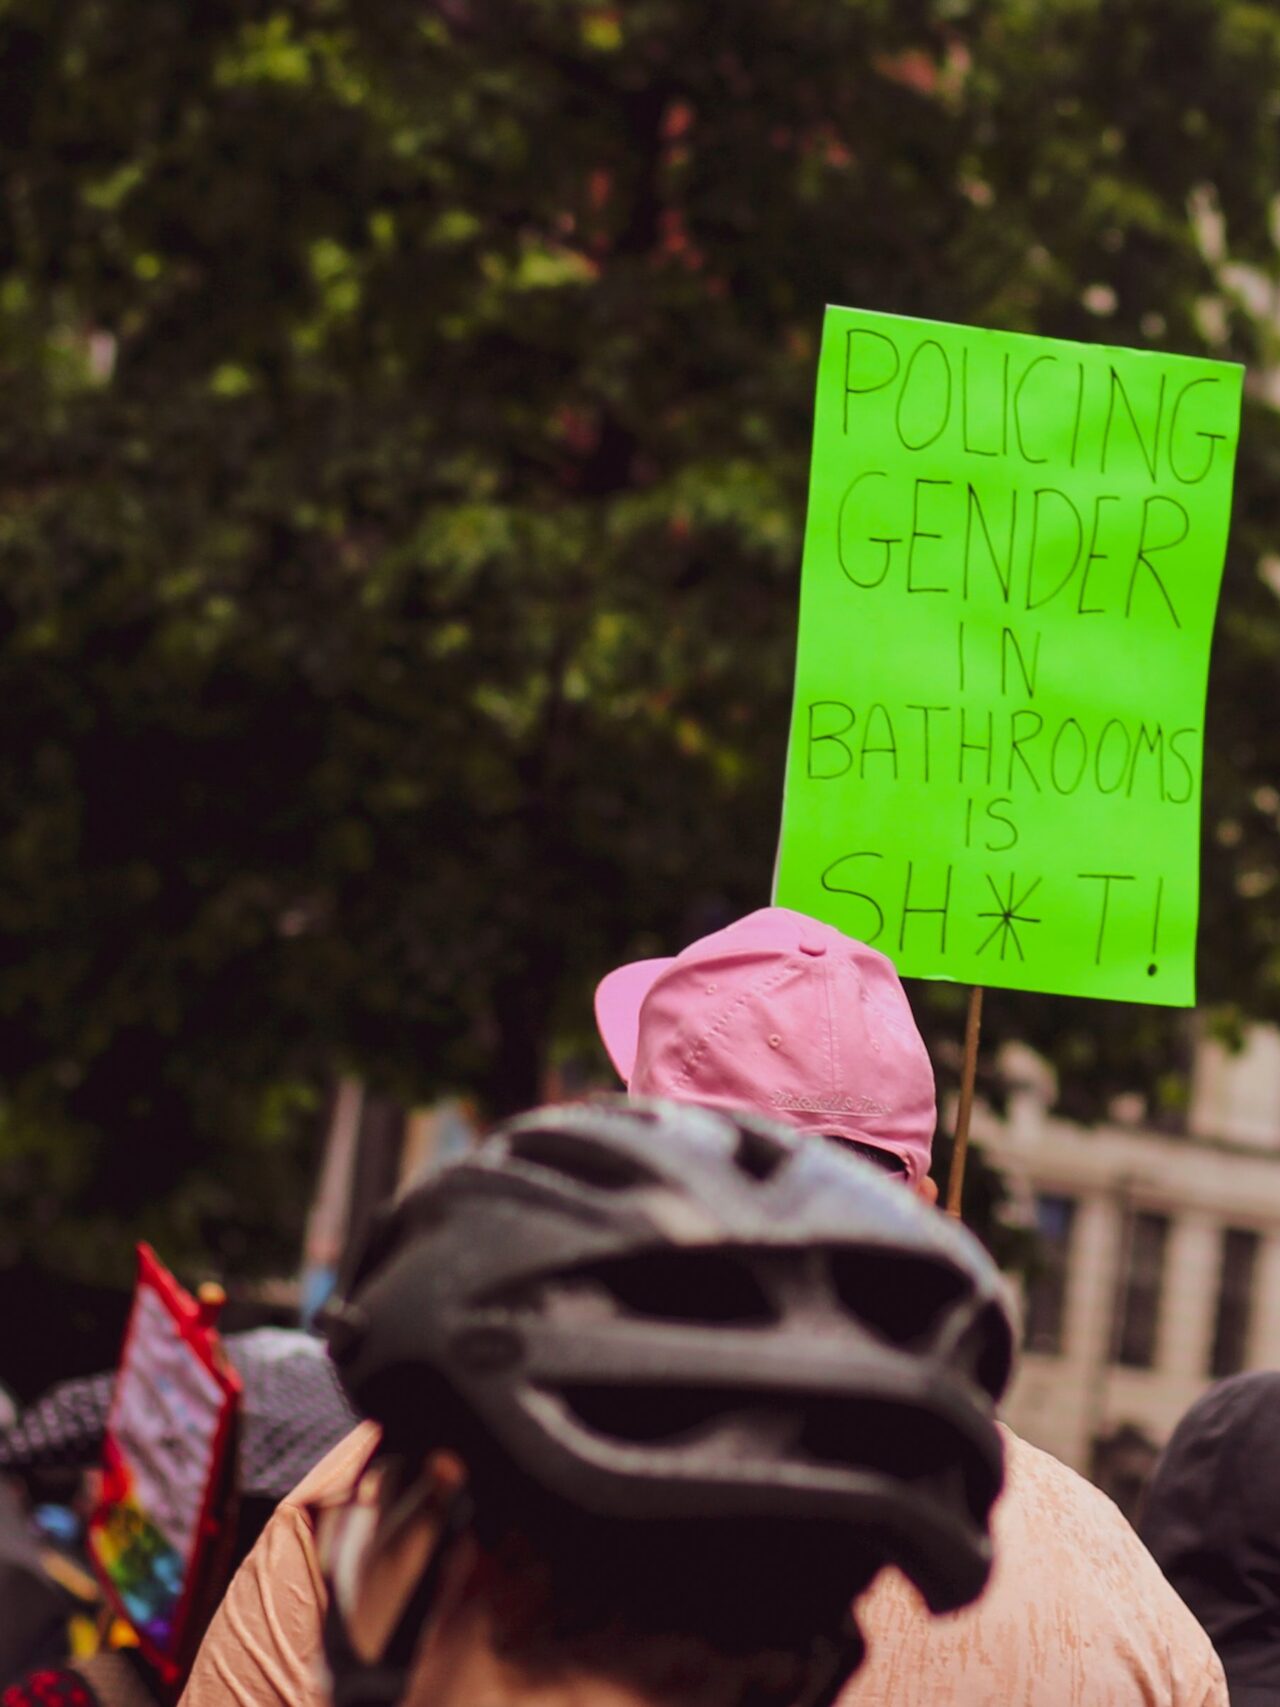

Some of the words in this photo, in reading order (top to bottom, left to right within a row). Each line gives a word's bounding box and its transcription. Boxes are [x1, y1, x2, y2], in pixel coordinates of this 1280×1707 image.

[842, 328, 1227, 484] POLICING
[837, 471, 1190, 628] GENDER
[959, 621, 1040, 698] IN
[807, 701, 1198, 804] BATHROOMS
[965, 798, 1019, 852] IS
